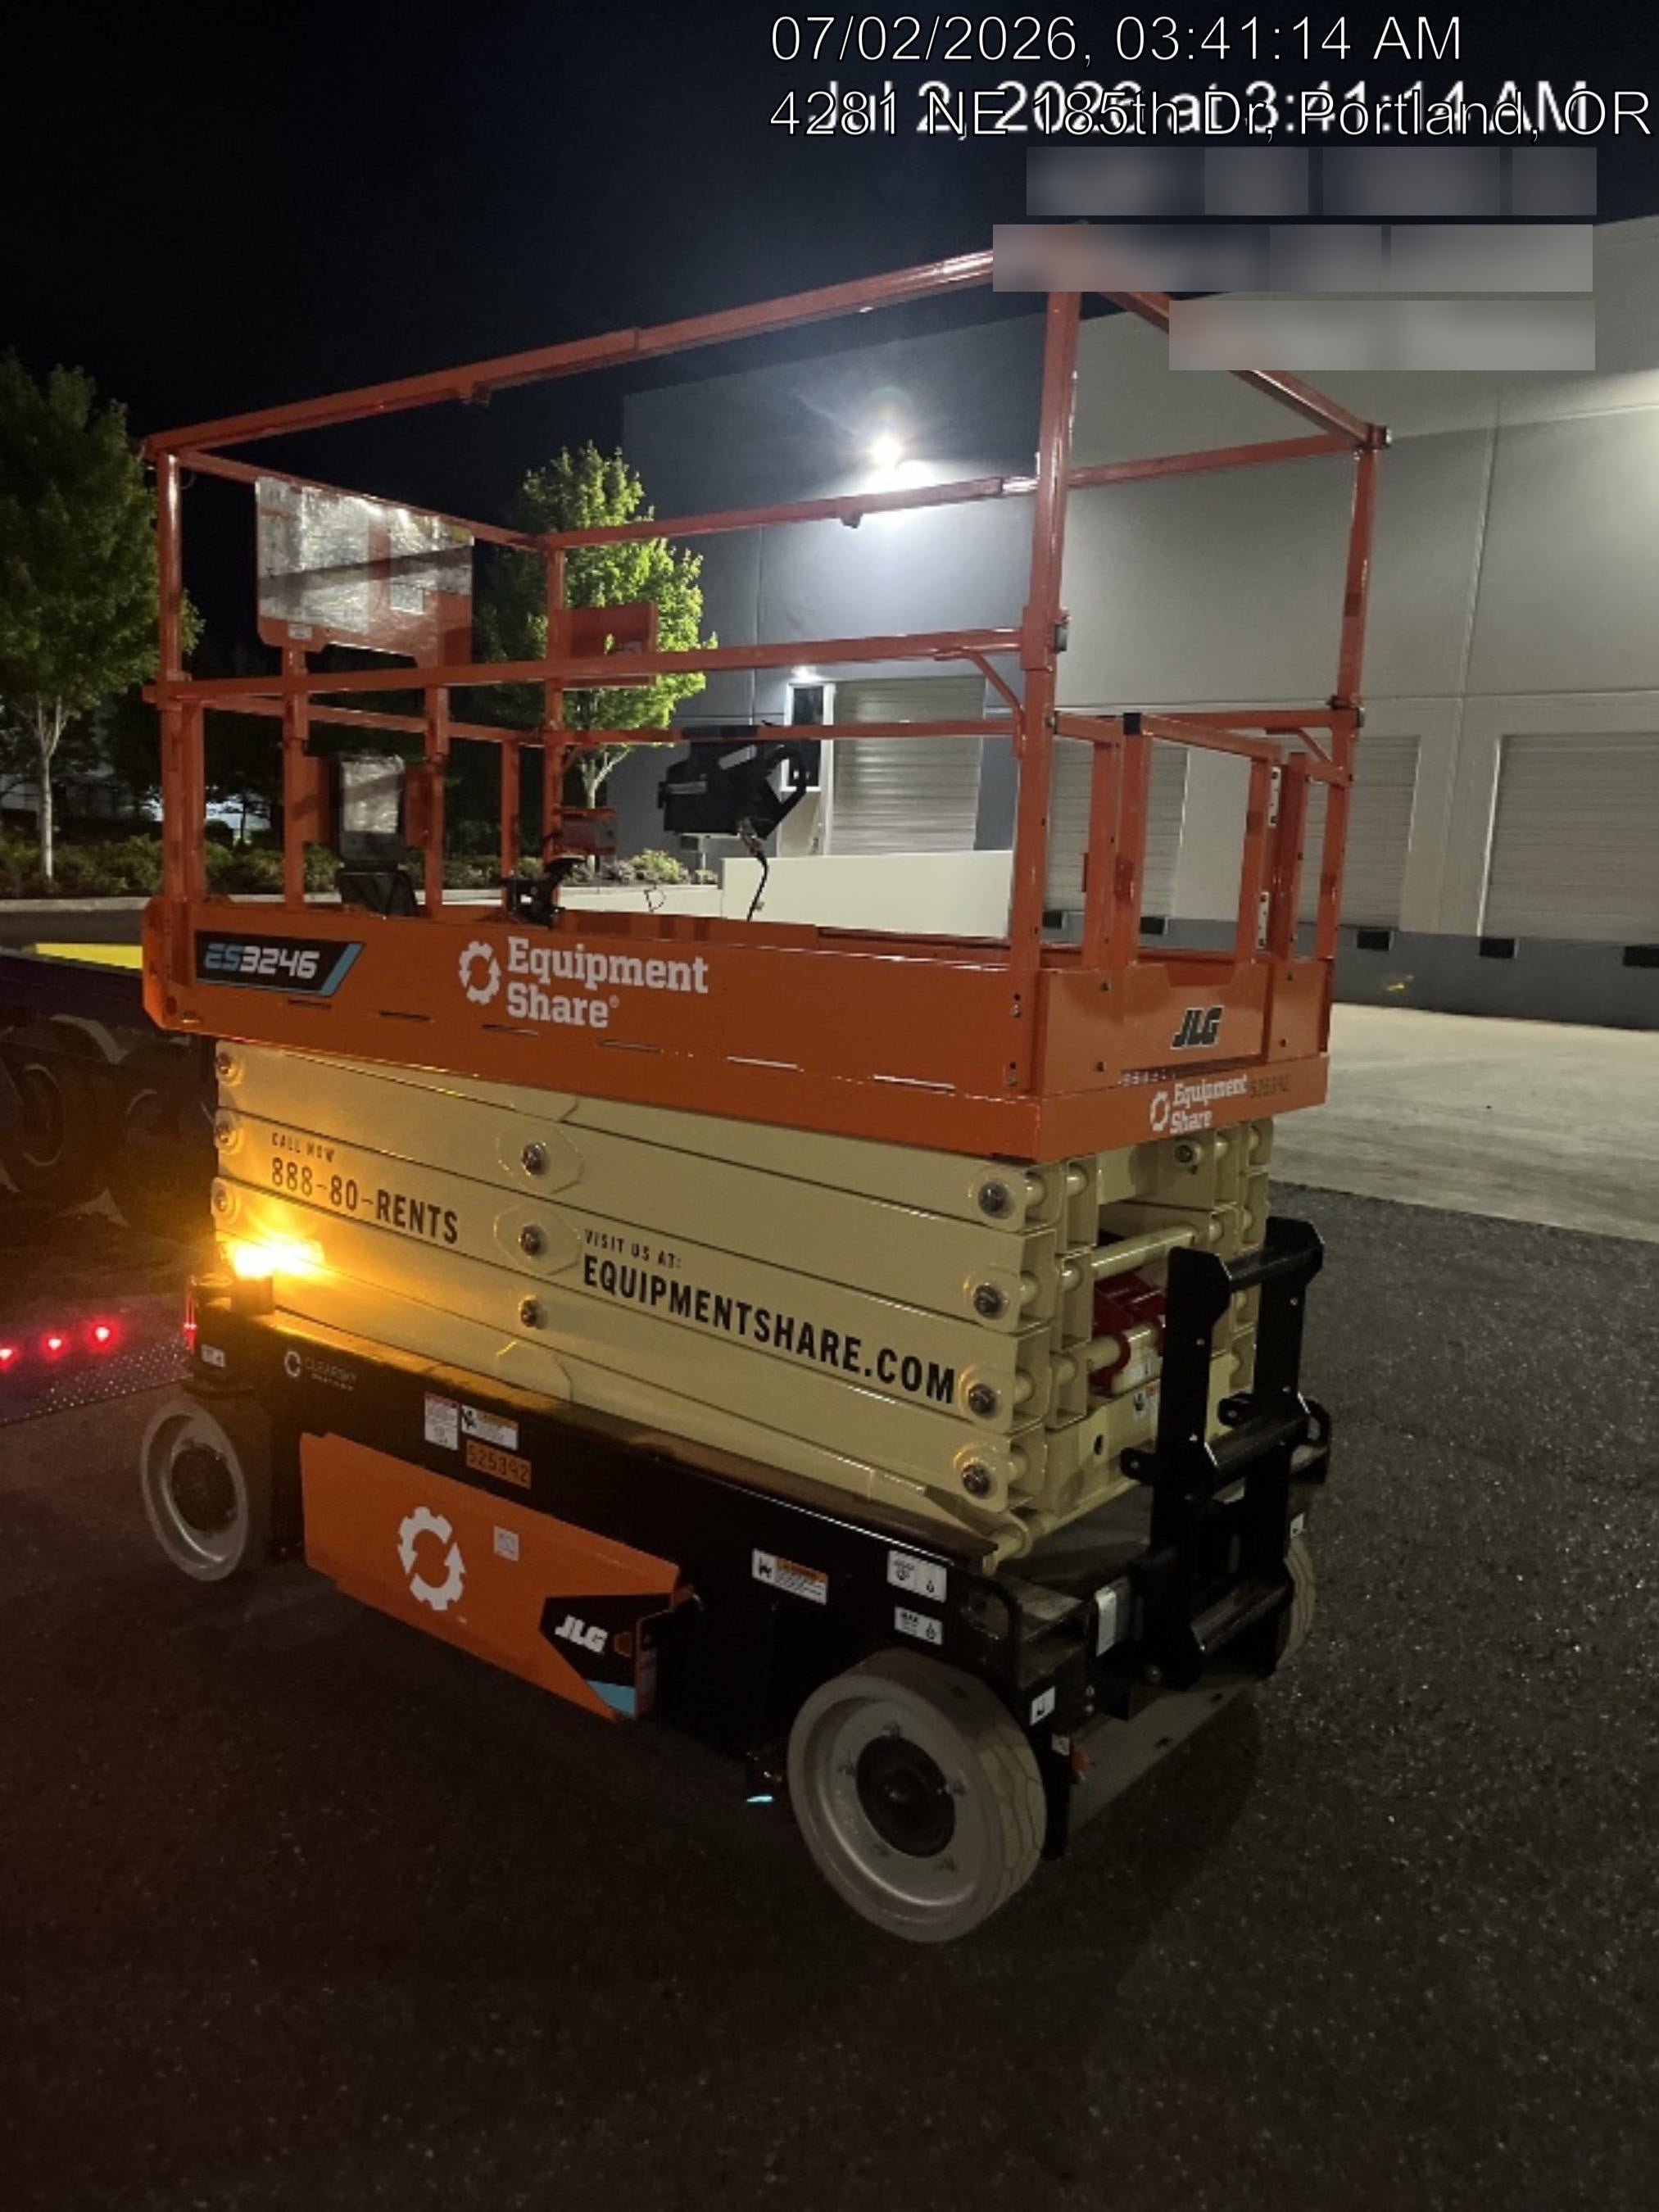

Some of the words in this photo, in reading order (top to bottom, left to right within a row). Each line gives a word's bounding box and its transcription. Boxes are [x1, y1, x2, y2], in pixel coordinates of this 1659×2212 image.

[204, 943, 320, 979] ES3246
[507, 936, 709, 994] Equipment
[1171, 1005, 1224, 1049] JLG
[1172, 1074, 1248, 1108] Equipment
[1170, 1110, 1213, 1135] Share
[272, 1132, 301, 1154] CALL
[306, 1141, 335, 1163] NOW
[271, 1156, 459, 1244] 888-80-RENTS
[585, 1229, 624, 1254] VISIT
[631, 1243, 649, 1262] US
[658, 1250, 682, 1269] AT:
[584, 1253, 955, 1404] EQUIPMENTSHARE.COM
[555, 1614, 609, 1653] JLG
